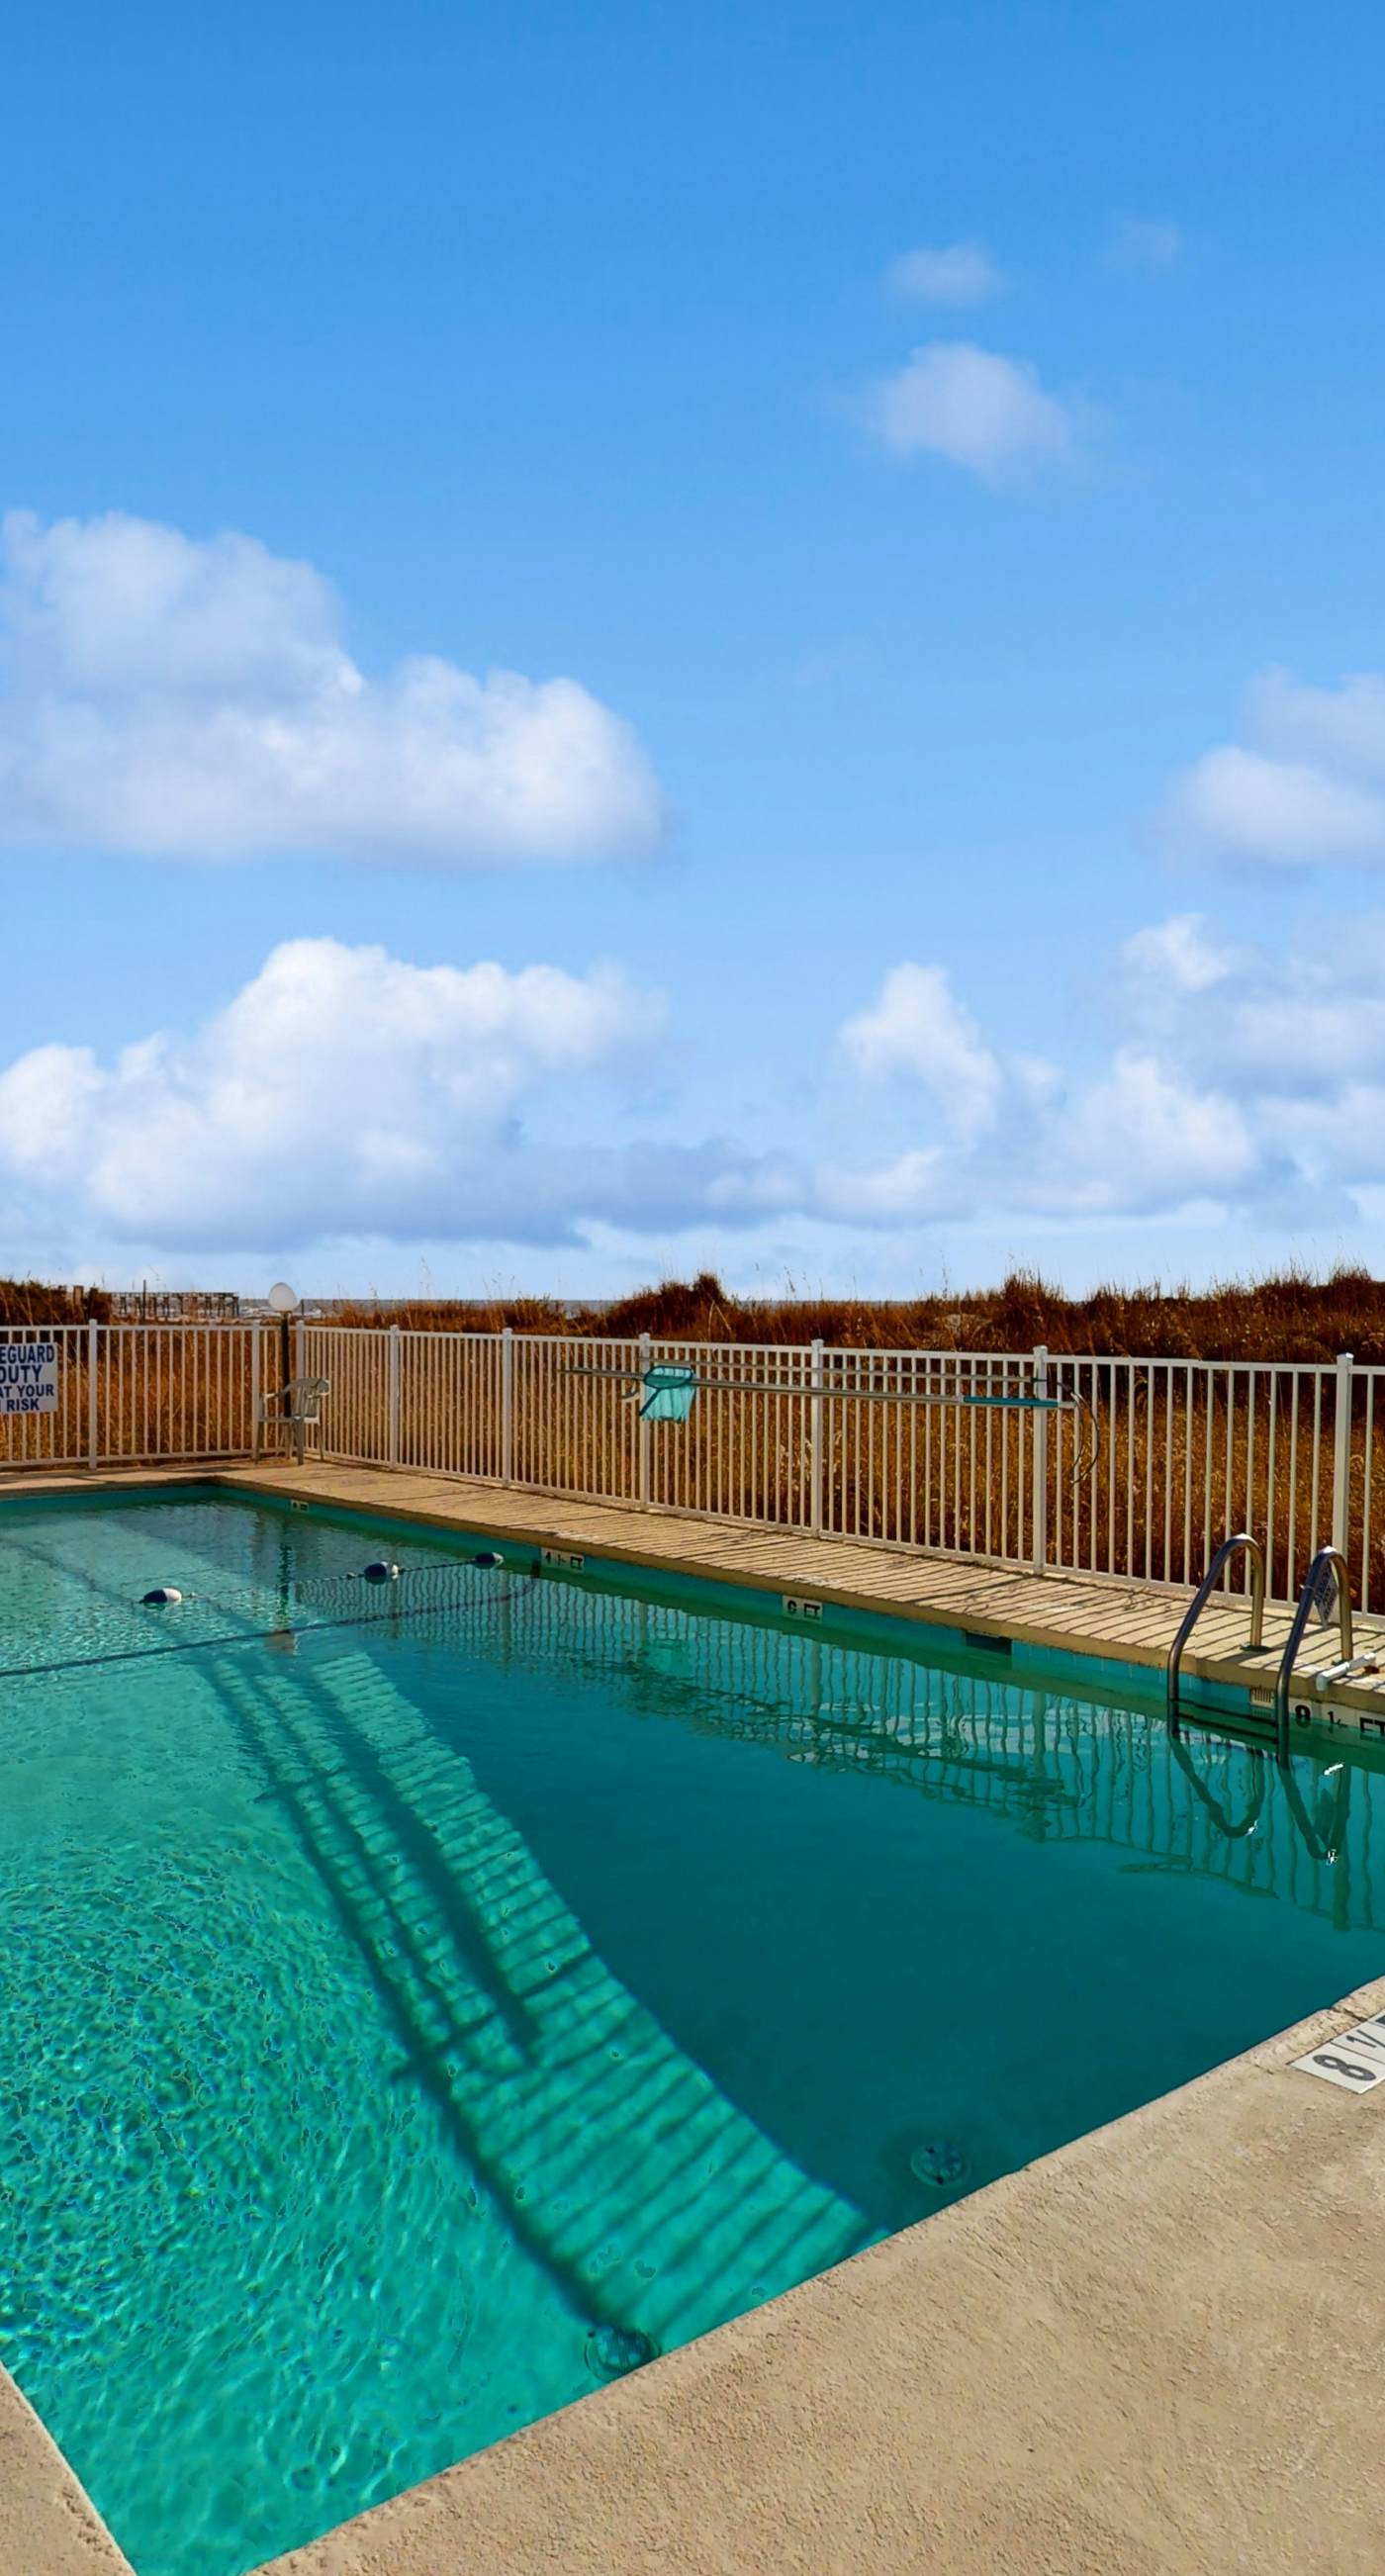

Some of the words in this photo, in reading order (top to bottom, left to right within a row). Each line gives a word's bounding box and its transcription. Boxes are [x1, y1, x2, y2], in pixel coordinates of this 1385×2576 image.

[17, 1384, 54, 1398] YOUR
[7, 1398, 40, 1412] RISK
[1312, 2054, 1377, 2081] 8
